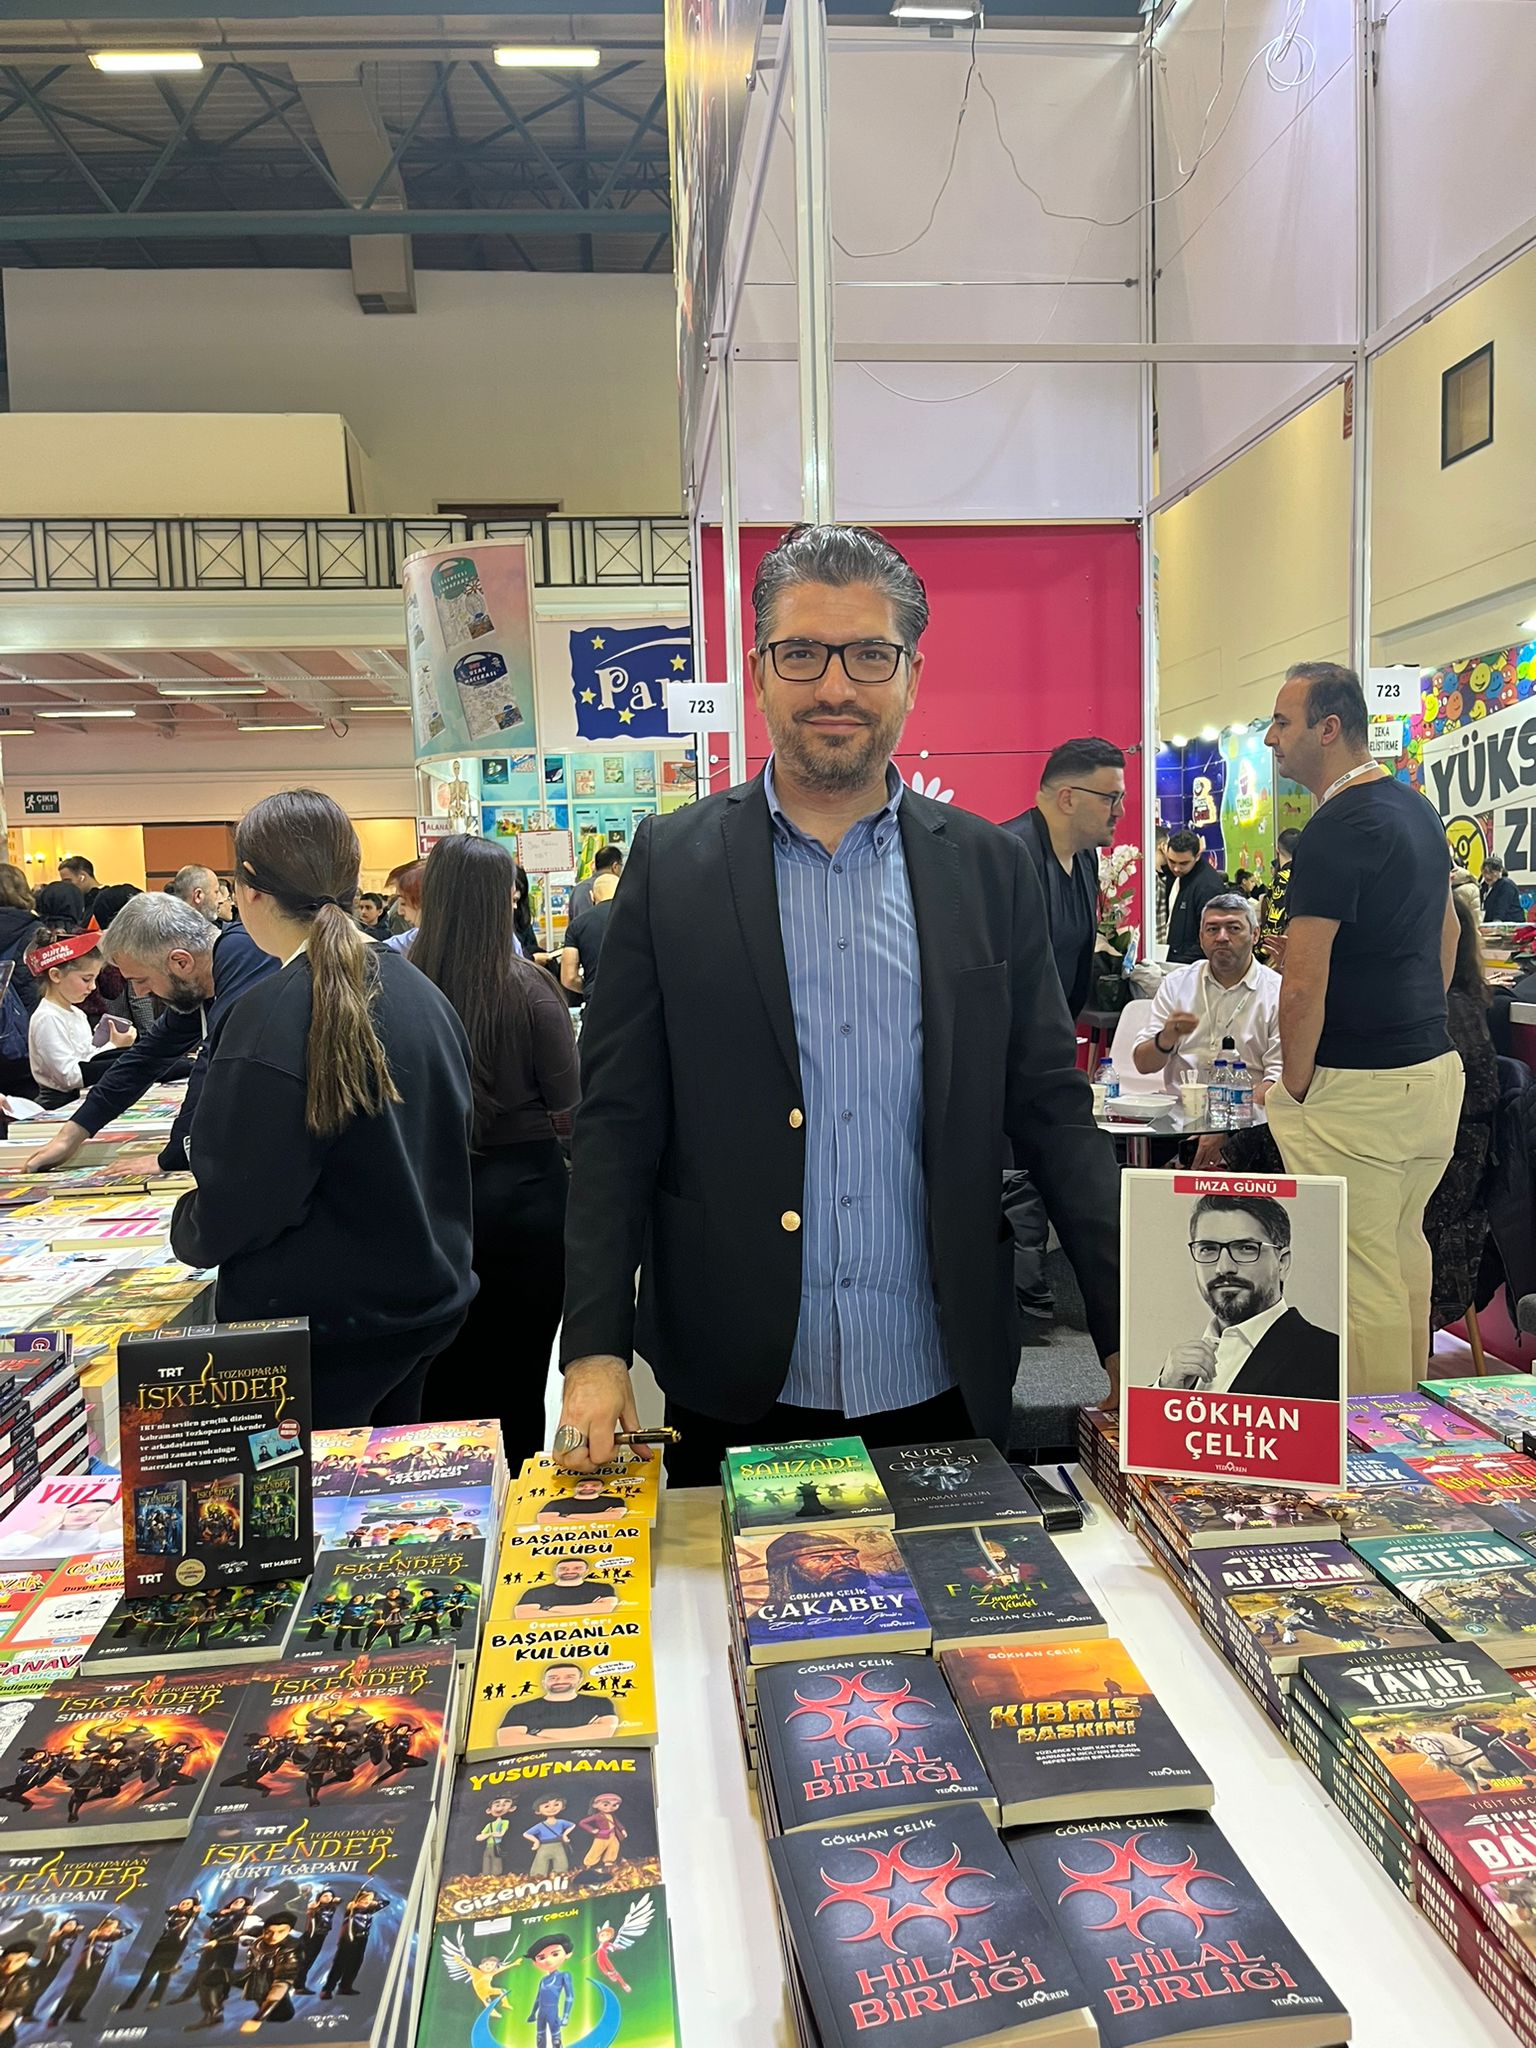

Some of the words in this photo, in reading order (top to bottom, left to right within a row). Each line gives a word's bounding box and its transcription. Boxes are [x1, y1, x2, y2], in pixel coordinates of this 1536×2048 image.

[1377, 685, 1401, 697] 723
[689, 700, 715, 713] 723
[1374, 726, 1390, 737] ZEKA
[1369, 739, 1399, 752] ELİŞTİRME
[36, 794, 58, 804] ÇIKIŞ
[1195, 1179, 1230, 1192] İMZA
[1234, 1179, 1277, 1195] GÜNÜ
[157, 1366, 184, 1378] TRT
[216, 1365, 287, 1380] TOZKOPARAN
[138, 1372, 288, 1413] İSKENDER
[172, 1420, 199, 1429] sevilen
[200, 1416, 228, 1427] gençlik
[230, 1413, 263, 1423] dizisinin
[1163, 1395, 1300, 1432] GÖKHAN
[140, 1431, 184, 1441] kahramanı
[185, 1427, 231, 1439] Tozkoparan
[232, 1422, 267, 1433] İskender
[758, 1443, 803, 1453] GÖKHAN
[805, 1440, 834, 1449] ÇELİK
[900, 1446, 955, 1459] KURT
[1185, 1430, 1279, 1462] ÇELİK
[140, 1452, 169, 1463] gizemli
[170, 1451, 197, 1459] zaman
[140, 1462, 184, 1472] maceraları
[185, 1458, 212, 1467] devam
[38, 1483, 108, 1505] YÜZ
[512, 1528, 639, 1546] BAŞARANLAR
[531, 1543, 613, 1556] KULÜBÜ
[1241, 1552, 1312, 1563] KUMANDAN
[274, 1557, 302, 1567] MARKET
[333, 1556, 464, 1576] İSKENDER
[1246, 1559, 1316, 1570] SULTAN
[1378, 1550, 1461, 1573] METE
[1464, 1545, 1525, 1565] HAN
[137, 1572, 164, 1585] TRT
[353, 1570, 380, 1582] ÇÖL
[385, 1567, 441, 1579] ASLANI
[1221, 1570, 1265, 1587] ALP
[1271, 1563, 1364, 1583] ARSLAN
[789, 1590, 834, 1601] GÖKHAN
[837, 1587, 867, 1598] ÇELİK
[758, 1593, 905, 1624] ÇAKABEY
[970, 1613, 1019, 1623] GÖKHAN
[1022, 1610, 1055, 1620] ÇELİK
[492, 1623, 639, 1648] BAŞARANLAR
[516, 1641, 610, 1661] KULÜBÜ
[987, 1651, 1043, 1660] GÖKHAN
[1046, 1647, 1082, 1657] ÇELİK
[311, 1664, 340, 1673] TRT
[797, 1661, 854, 1675] GÖKHAN
[858, 1658, 894, 1669] ÇELİK
[1365, 1658, 1444, 1674] KUMANDAN
[103, 1684, 133, 1692] TRT
[271, 1668, 428, 1695] İSKENDER
[1350, 1665, 1482, 1696] YAVUZ
[58, 1688, 223, 1712] İSKENDER
[270, 1692, 345, 1707] SİMURG
[350, 1685, 404, 1699] ATEŞİ
[1374, 1691, 1439, 1705] SULTAN
[54, 1709, 130, 1723] SİMURG
[136, 1704, 194, 1718] ATEŞİ
[989, 1697, 1143, 1729] KIBRIS
[1017, 1720, 1137, 1744] BASKINI
[1035, 1747, 1071, 1756] YÜZLERCE
[1036, 1752, 1077, 1761] BARNABAS
[498, 1758, 516, 1766] TRT
[811, 1746, 942, 1777] HİLAL
[470, 1759, 636, 1790] YUSUFNAME
[802, 1761, 961, 1801] BİRLİĞİ
[1469, 1799, 1505, 1810] YİĞİT
[255, 1825, 288, 1836] TRT
[309, 1828, 396, 1840] TOZKOPARAN
[821, 1827, 890, 1847] GÖKHAN
[893, 1818, 937, 1837] ÇELİK
[1054, 1820, 1122, 1837] GÖKHAN
[1125, 1816, 1168, 1831] ÇELİK
[201, 1836, 394, 1867] İSKENDER
[9, 1857, 43, 1867] TRT
[63, 1858, 150, 1871] TOZKOPARAN
[219, 1865, 276, 1880] KURT
[280, 1860, 360, 1876] KAPANI
[28, 1889, 109, 1905] KAPANI
[453, 1876, 569, 1915] Gizemli
[522, 1917, 543, 1925] TRT
[855, 1938, 1017, 1995] HİLAL
[1104, 1939, 1266, 1983] HİLAL
[849, 1956, 1046, 2031] BİRLİĞİ
[1103, 1961, 1298, 2015] BİRLİĞİ
